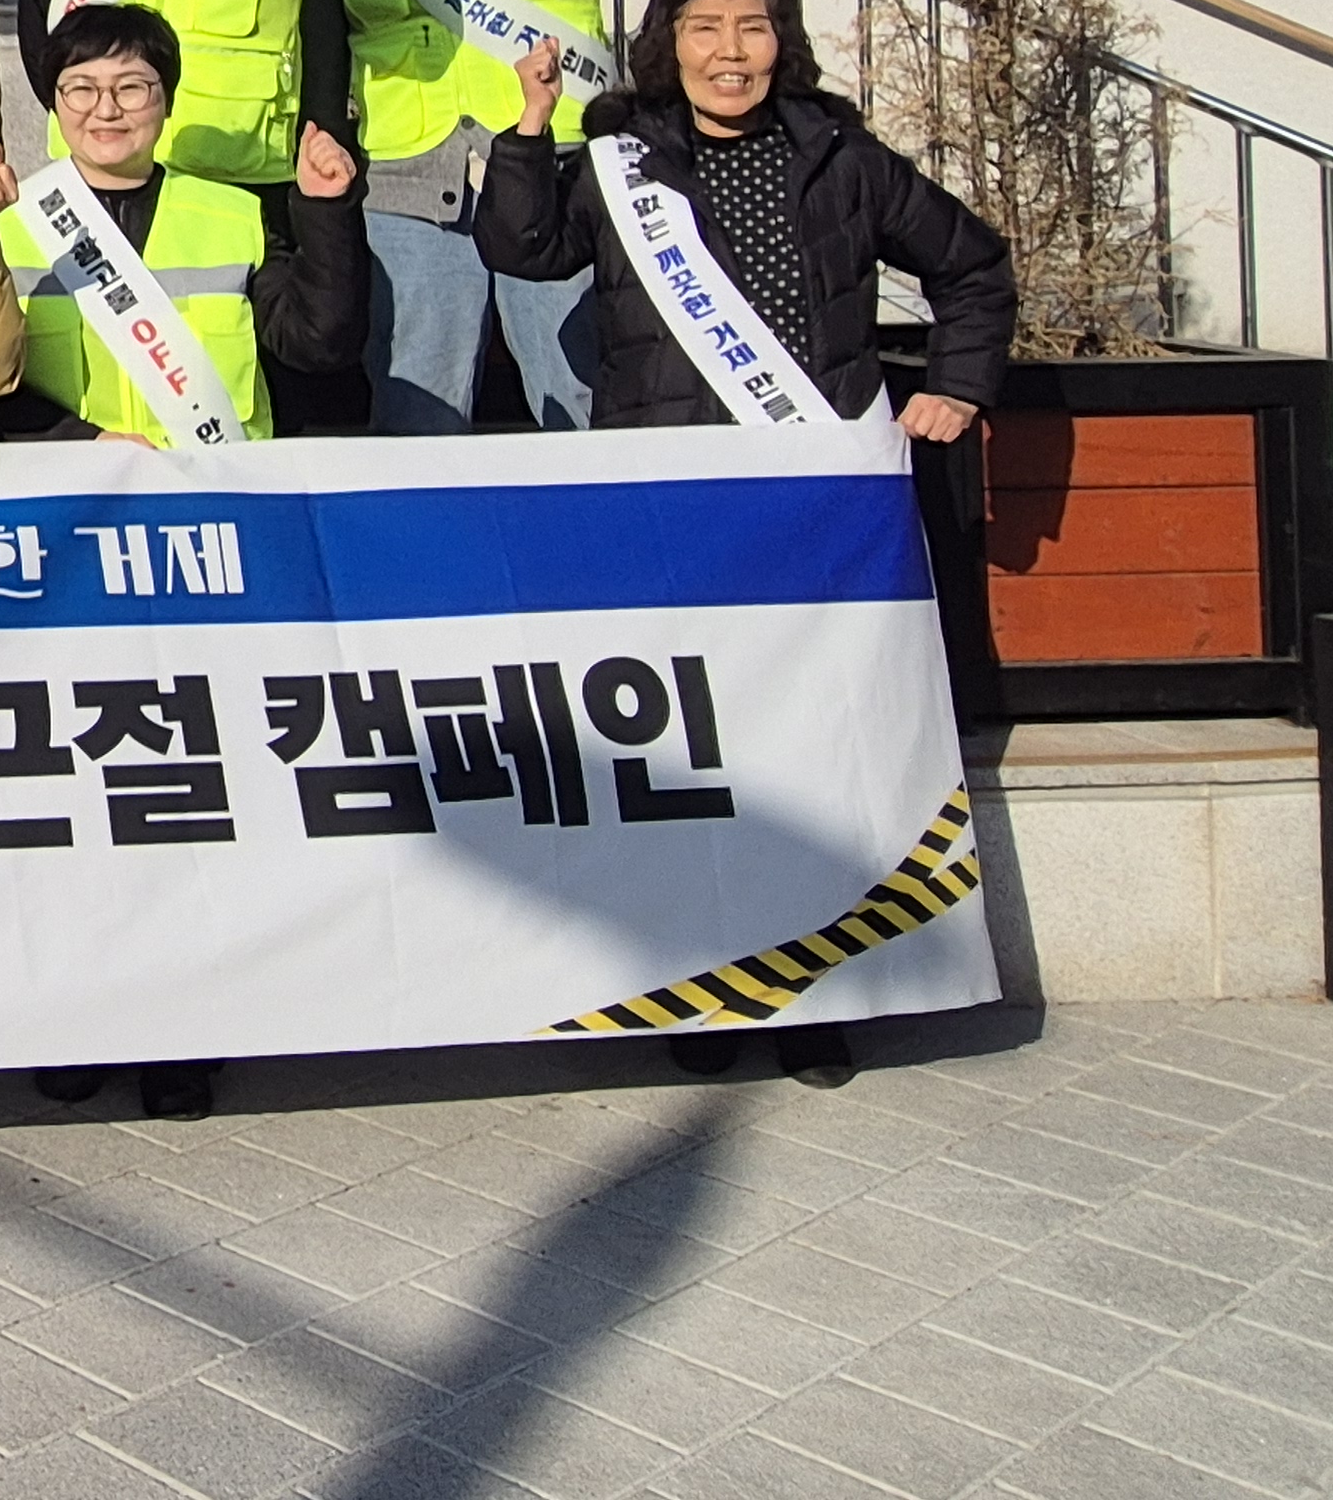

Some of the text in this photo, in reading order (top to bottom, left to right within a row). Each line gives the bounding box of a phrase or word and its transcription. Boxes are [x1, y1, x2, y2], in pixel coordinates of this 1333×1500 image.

[38, 188, 188, 397] 불법 광고물 OFF
[632, 194, 670, 242] 없는
[654, 244, 717, 320] 깨끗한
[704, 320, 758, 372] 거제
[74, 521, 246, 598] 거제
[263, 656, 736, 838] 캠페인
